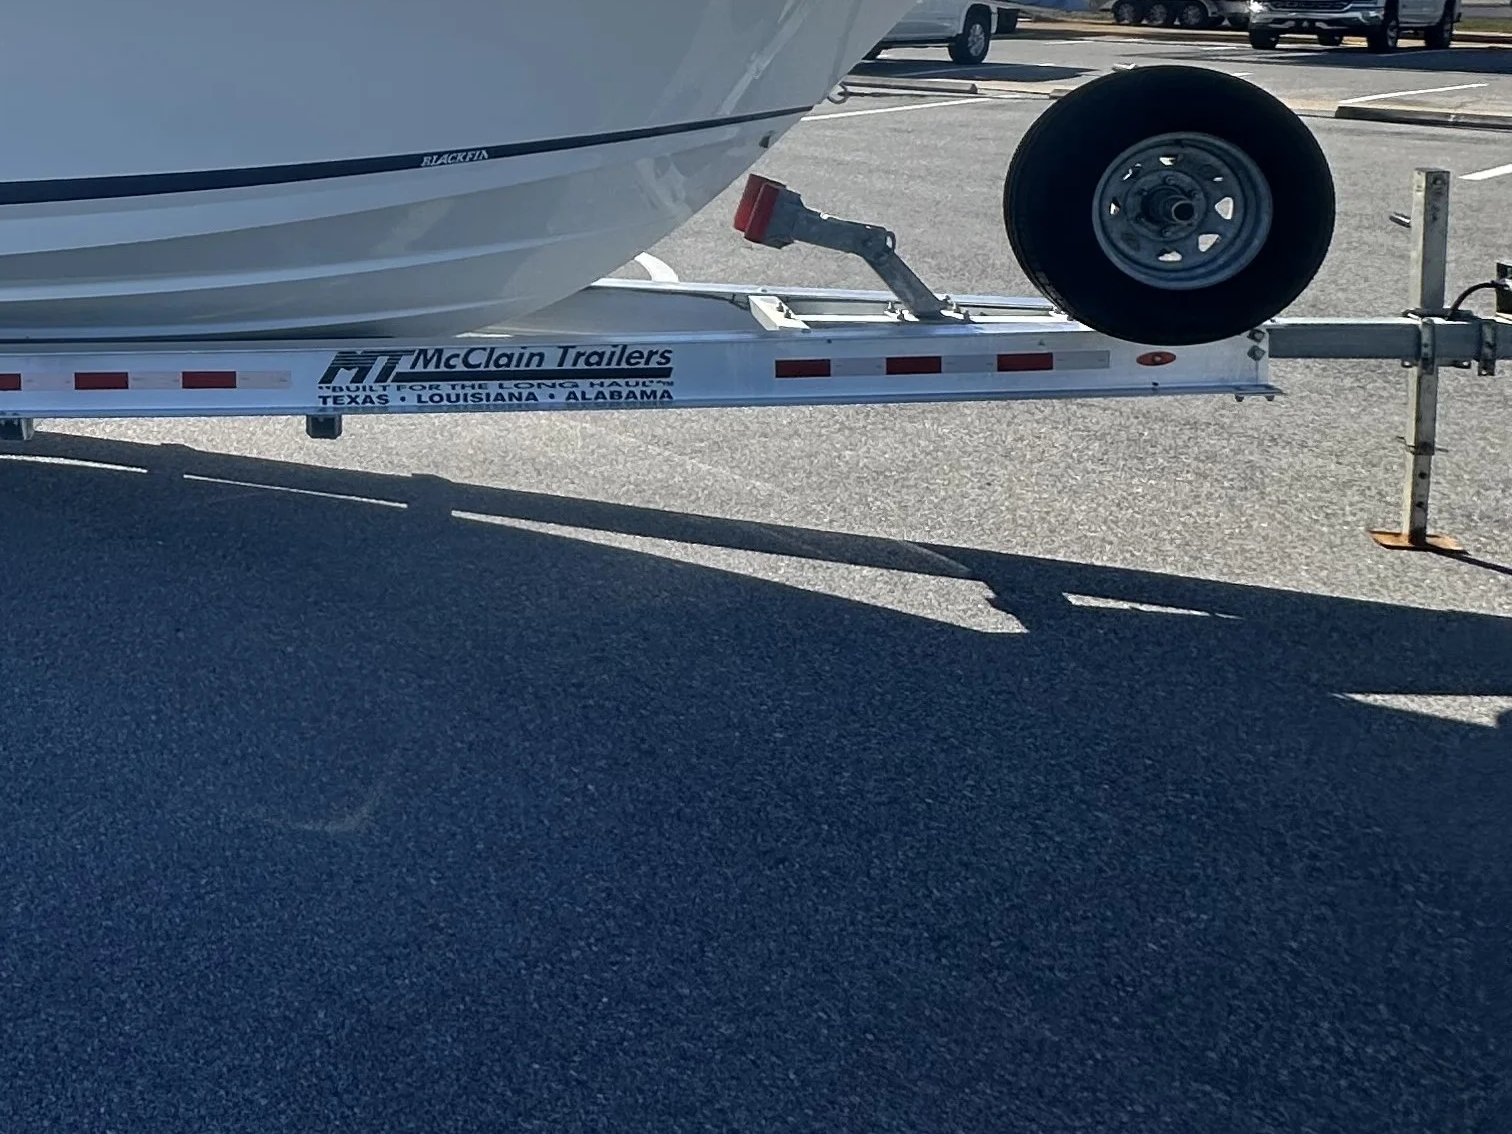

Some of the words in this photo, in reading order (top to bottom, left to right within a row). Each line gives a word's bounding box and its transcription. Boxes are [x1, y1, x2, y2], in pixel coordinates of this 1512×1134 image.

[420, 149, 489, 167] BLACKFIN
[409, 346, 545, 370] McClain
[556, 344, 673, 368] Trailers
[396, 383, 441, 392] FOR
[449, 382, 489, 391] THE
[497, 380, 580, 390] LONG
[317, 393, 390, 406] TEXAS
[416, 391, 540, 405] LOUISIANA
[564, 389, 675, 402] ALABAMA
